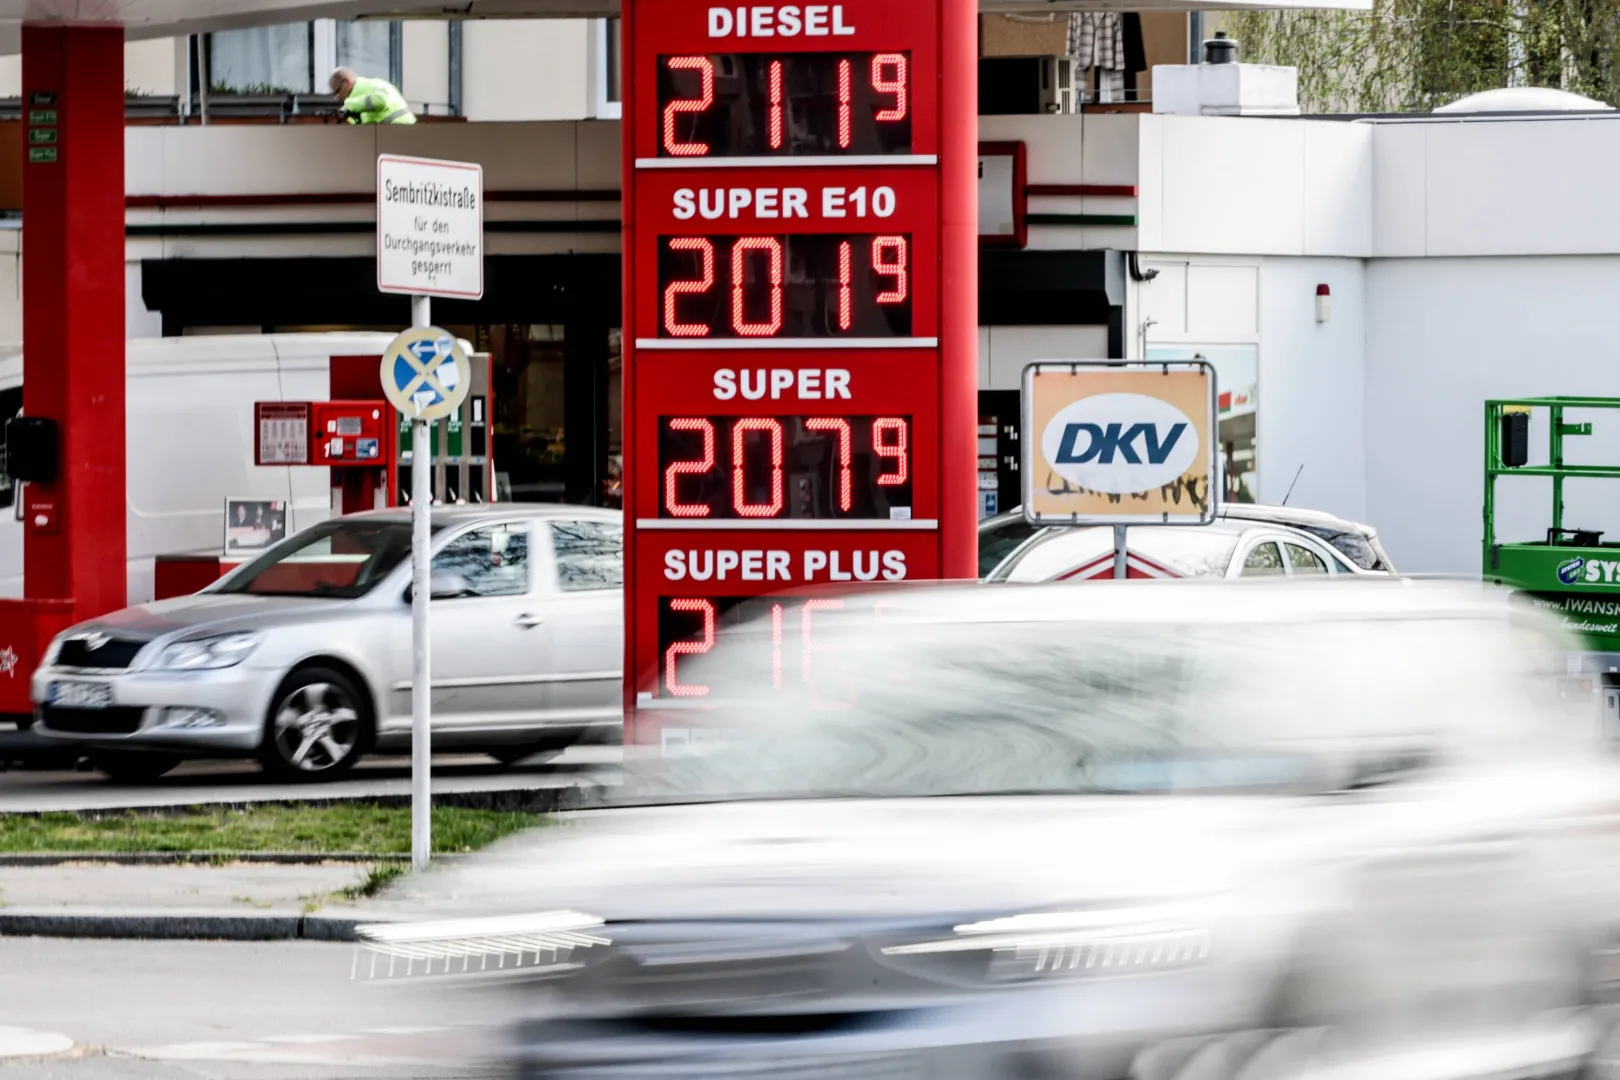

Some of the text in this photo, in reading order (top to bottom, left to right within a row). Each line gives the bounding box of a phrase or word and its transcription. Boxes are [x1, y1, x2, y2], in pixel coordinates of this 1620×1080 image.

[708, 6, 855, 37] DIESEL
[385, 178, 475, 210] Sembritzkistraße
[672, 186, 896, 219] SUPER E10
[414, 216, 449, 233] für den
[384, 233, 476, 257] Durchgangsverkehr
[411, 259, 452, 277] gesperrt
[713, 368, 852, 400] SUPER
[1055, 423, 1188, 464] DKV
[664, 550, 907, 581] SUPER PLUS
[1585, 559, 1620, 582] SY
